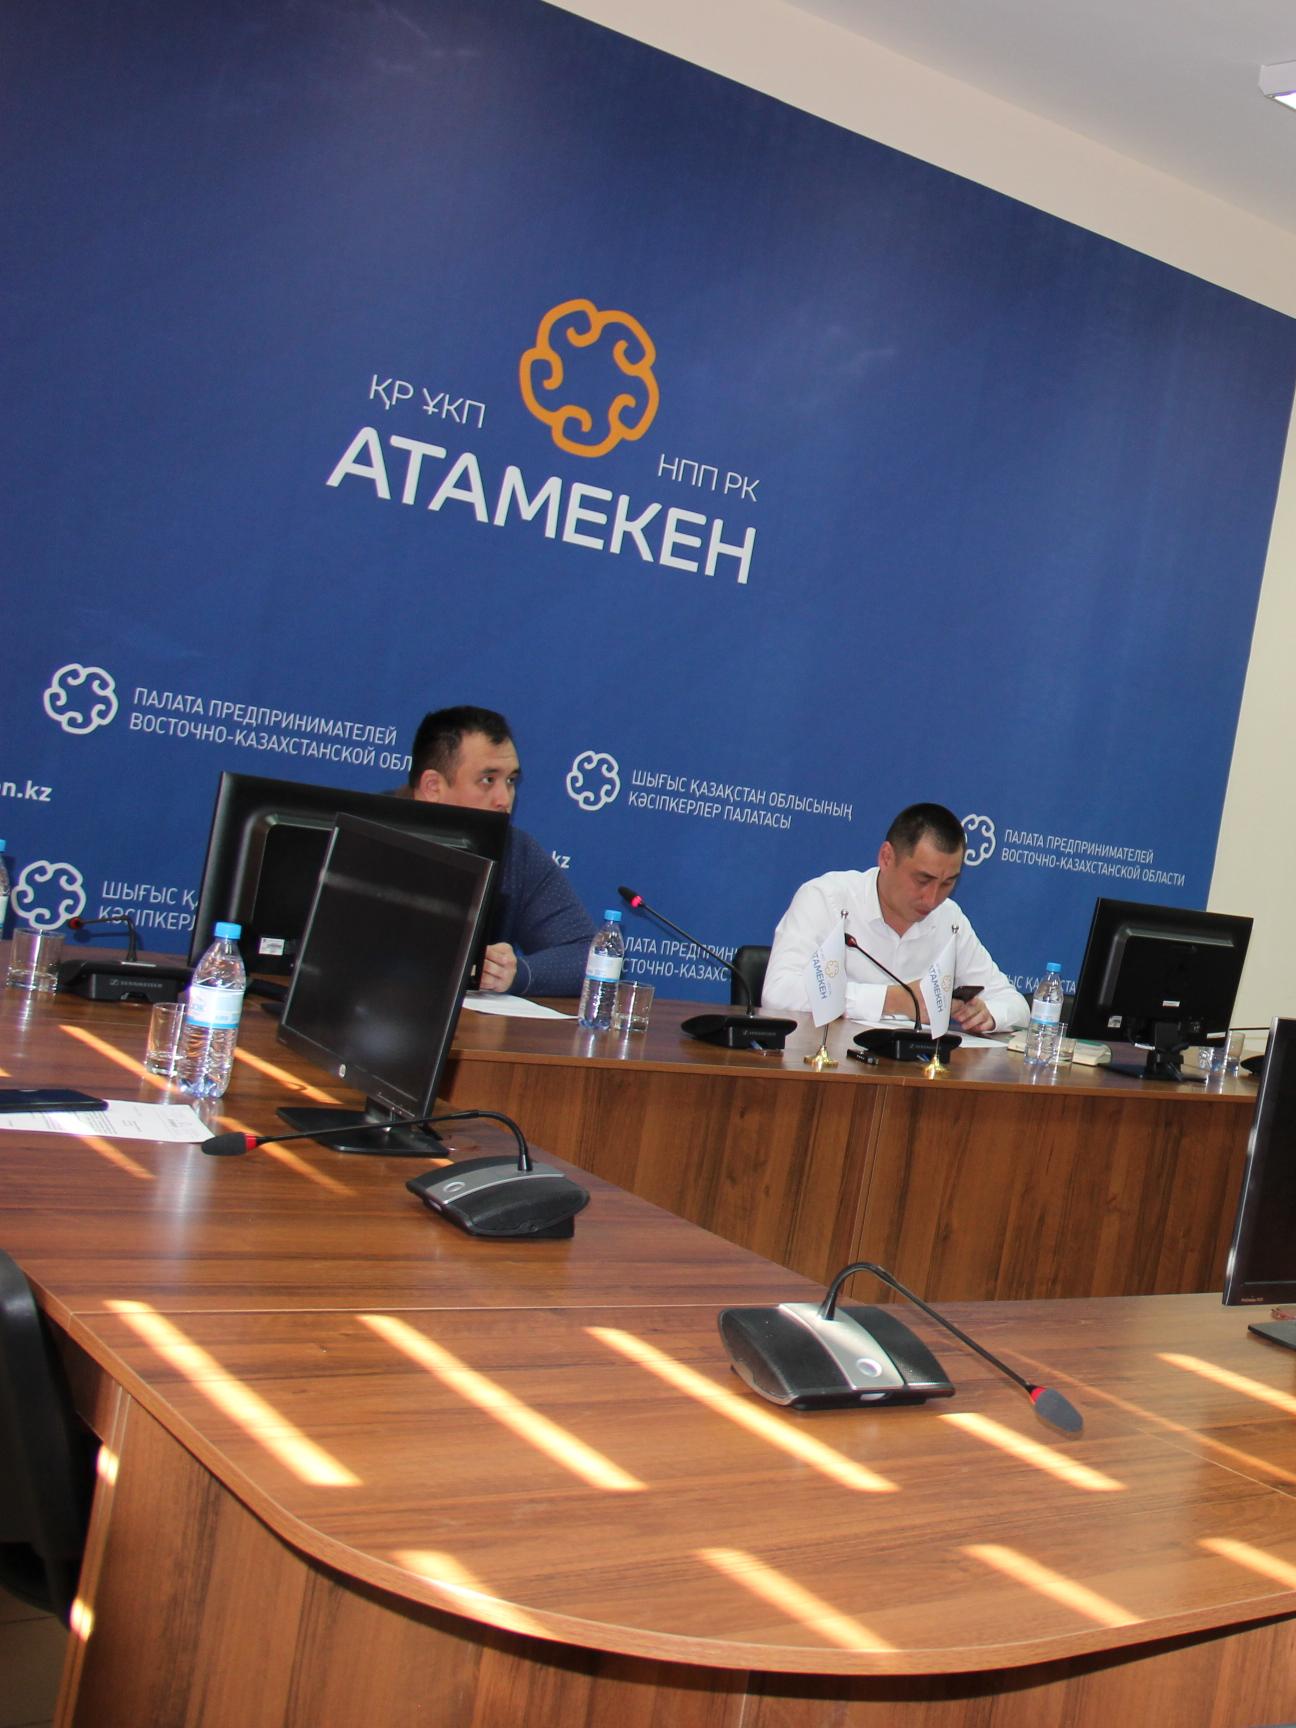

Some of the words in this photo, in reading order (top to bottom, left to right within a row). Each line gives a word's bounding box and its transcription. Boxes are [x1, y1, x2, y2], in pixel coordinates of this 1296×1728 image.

[368, 373, 414, 410] ҚР
[422, 387, 486, 428] ҰКП
[657, 452, 718, 491] НПП
[724, 470, 761, 502] РК
[325, 426, 757, 584] АТАМЕКЕН
[133, 687, 204, 715] ПАЛАТА
[208, 699, 397, 746] ПРЕДПРИНИМАТЕЛЕЙ
[129, 712, 376, 767] ВОСТОЧНО-КАЗАХСТАНСКОЙ
[0, 780, 53, 802] n.kz
[628, 790, 722, 818] КӘСІПКЕРЛЕР
[724, 805, 792, 829] ПАЛАТАСЫ
[631, 768, 688, 792] ШЫҒЫС
[690, 778, 766, 805] ҚАЗАҚСТАН
[768, 791, 853, 822] ОБЛЫСЫНЫҢ
[1001, 847, 1141, 881] ВОСТОЧНО-КАЗАХСТАНСКОЙ
[1142, 868, 1186, 887] ОБЛАСТИ
[1004, 828, 1044, 848] ПАЛАТА
[1046, 835, 1154, 864] ПРЕДПРИНИМАТЕЛЕЙ
[102, 880, 178, 905] ШЫҒЫС
[660, 940, 738, 962] ПРЕДПРИН
